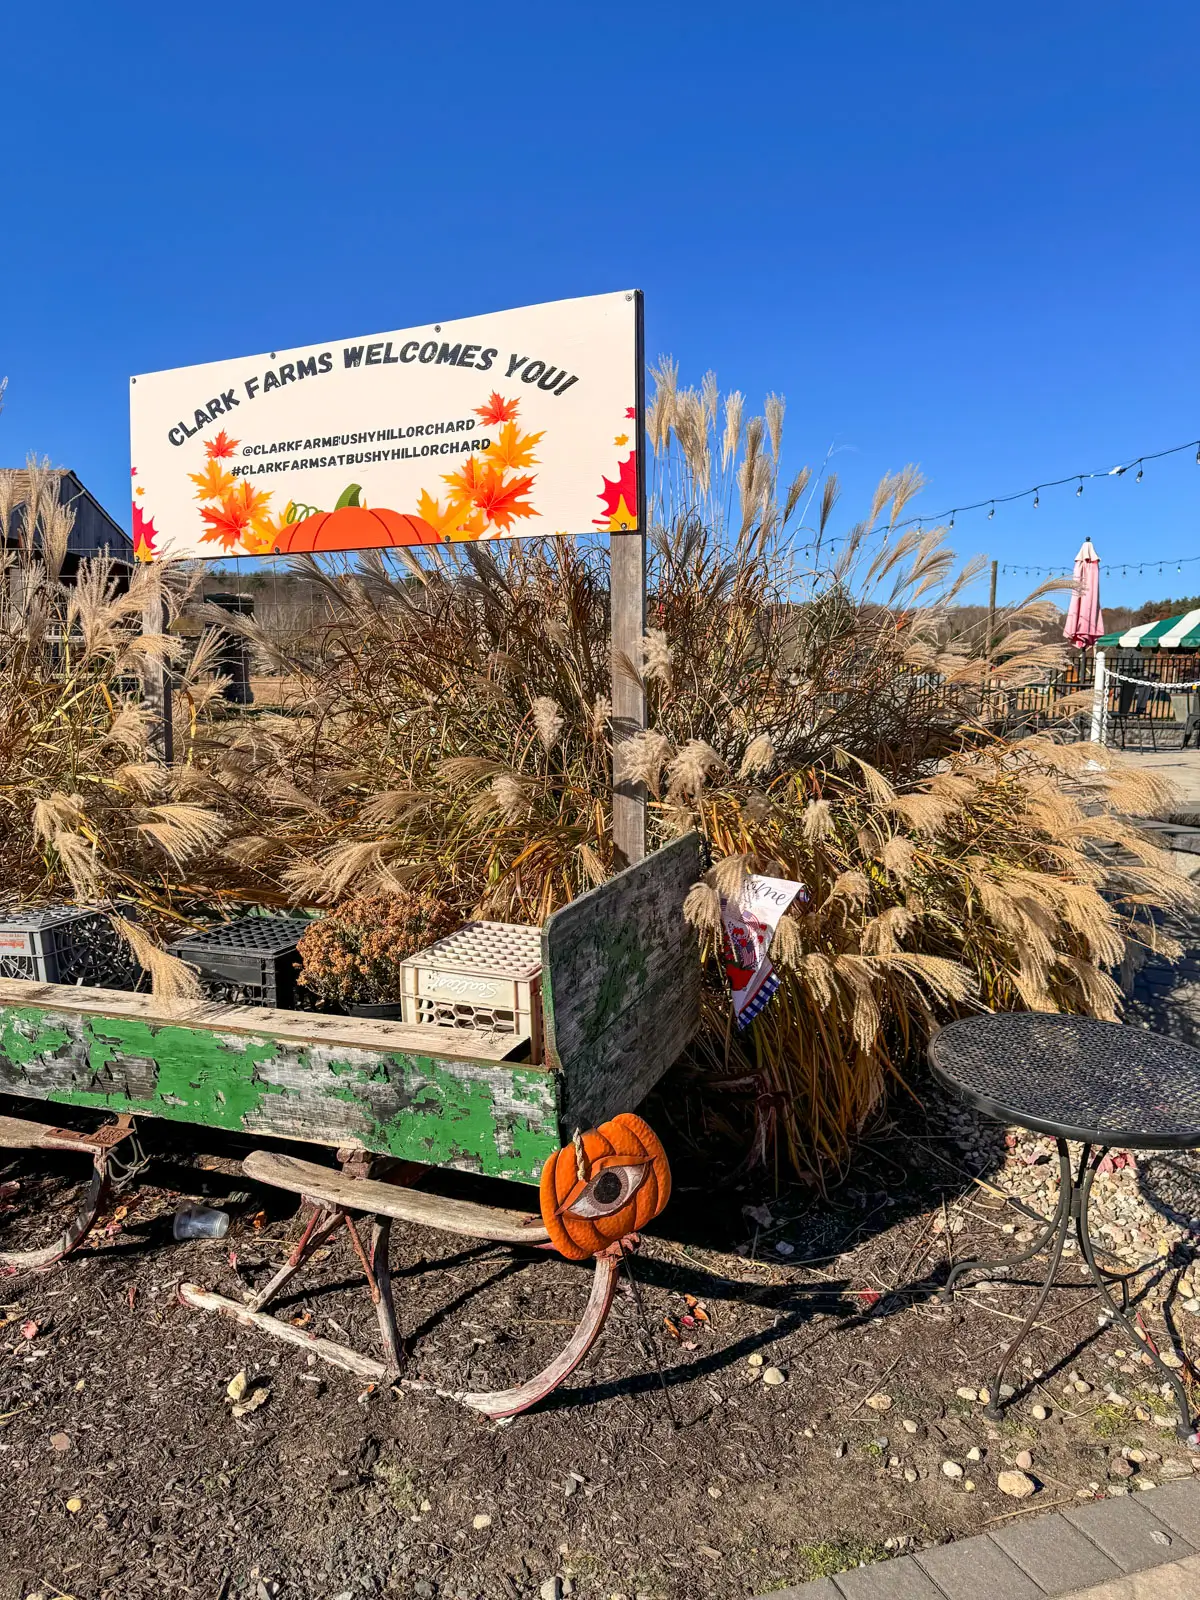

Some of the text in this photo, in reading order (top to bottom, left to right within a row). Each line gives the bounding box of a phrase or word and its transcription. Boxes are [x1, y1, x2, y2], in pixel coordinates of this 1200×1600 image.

[168, 341, 579, 447] CLARK FARMS WELCOMES YOU!
[231, 438, 491, 477] #CLARKFARMSATBUSHYHILLORCHARD
